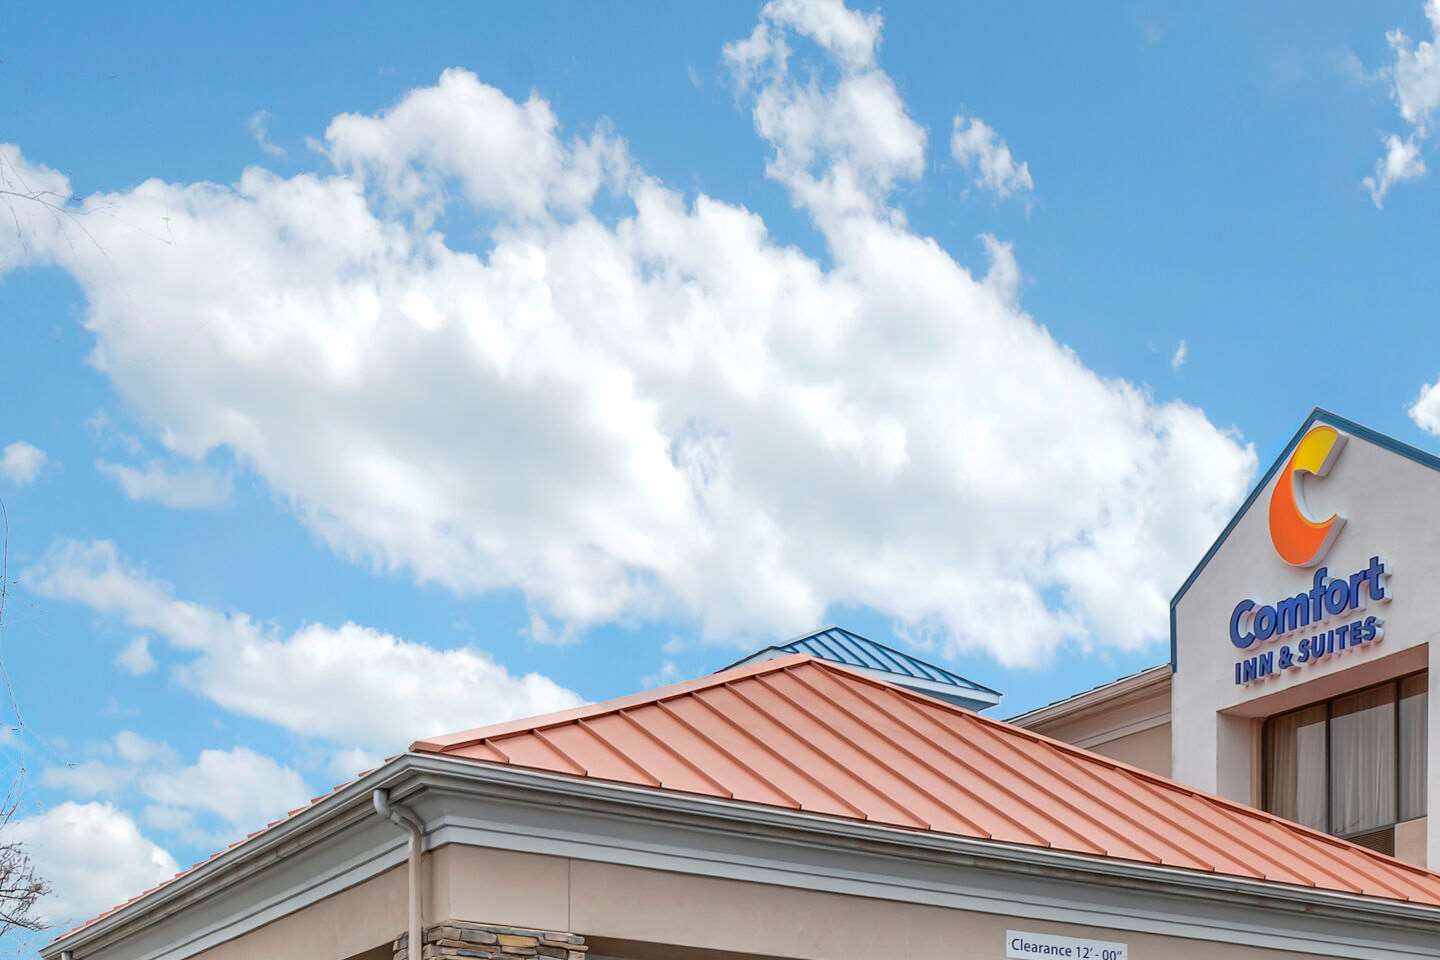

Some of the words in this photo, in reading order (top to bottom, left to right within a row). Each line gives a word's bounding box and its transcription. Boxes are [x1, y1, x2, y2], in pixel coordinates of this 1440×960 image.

[1229, 556, 1387, 649] Comfort
[1235, 651, 1274, 685] INN
[1279, 645, 1293, 668] &
[1297, 615, 1378, 663] SUITES
[1011, 938, 1072, 957] Clearance
